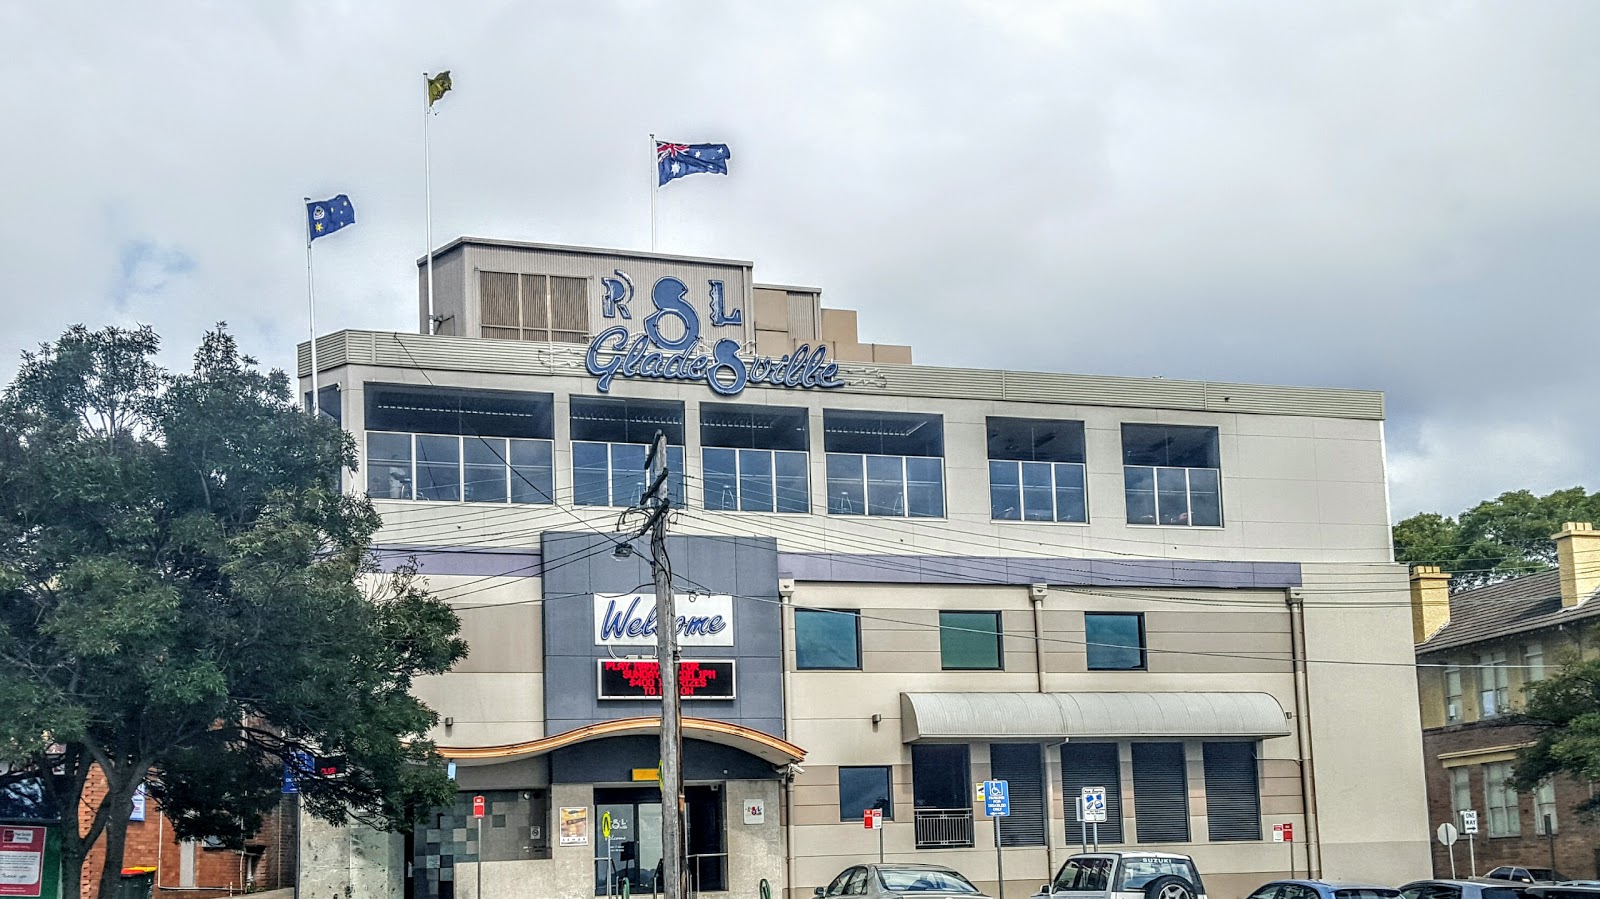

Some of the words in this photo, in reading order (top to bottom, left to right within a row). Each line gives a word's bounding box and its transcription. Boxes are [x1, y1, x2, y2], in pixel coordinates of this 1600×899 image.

[601, 596, 726, 640] Welome
[629, 678, 655, 687] $400
[643, 686, 656, 695] TO
